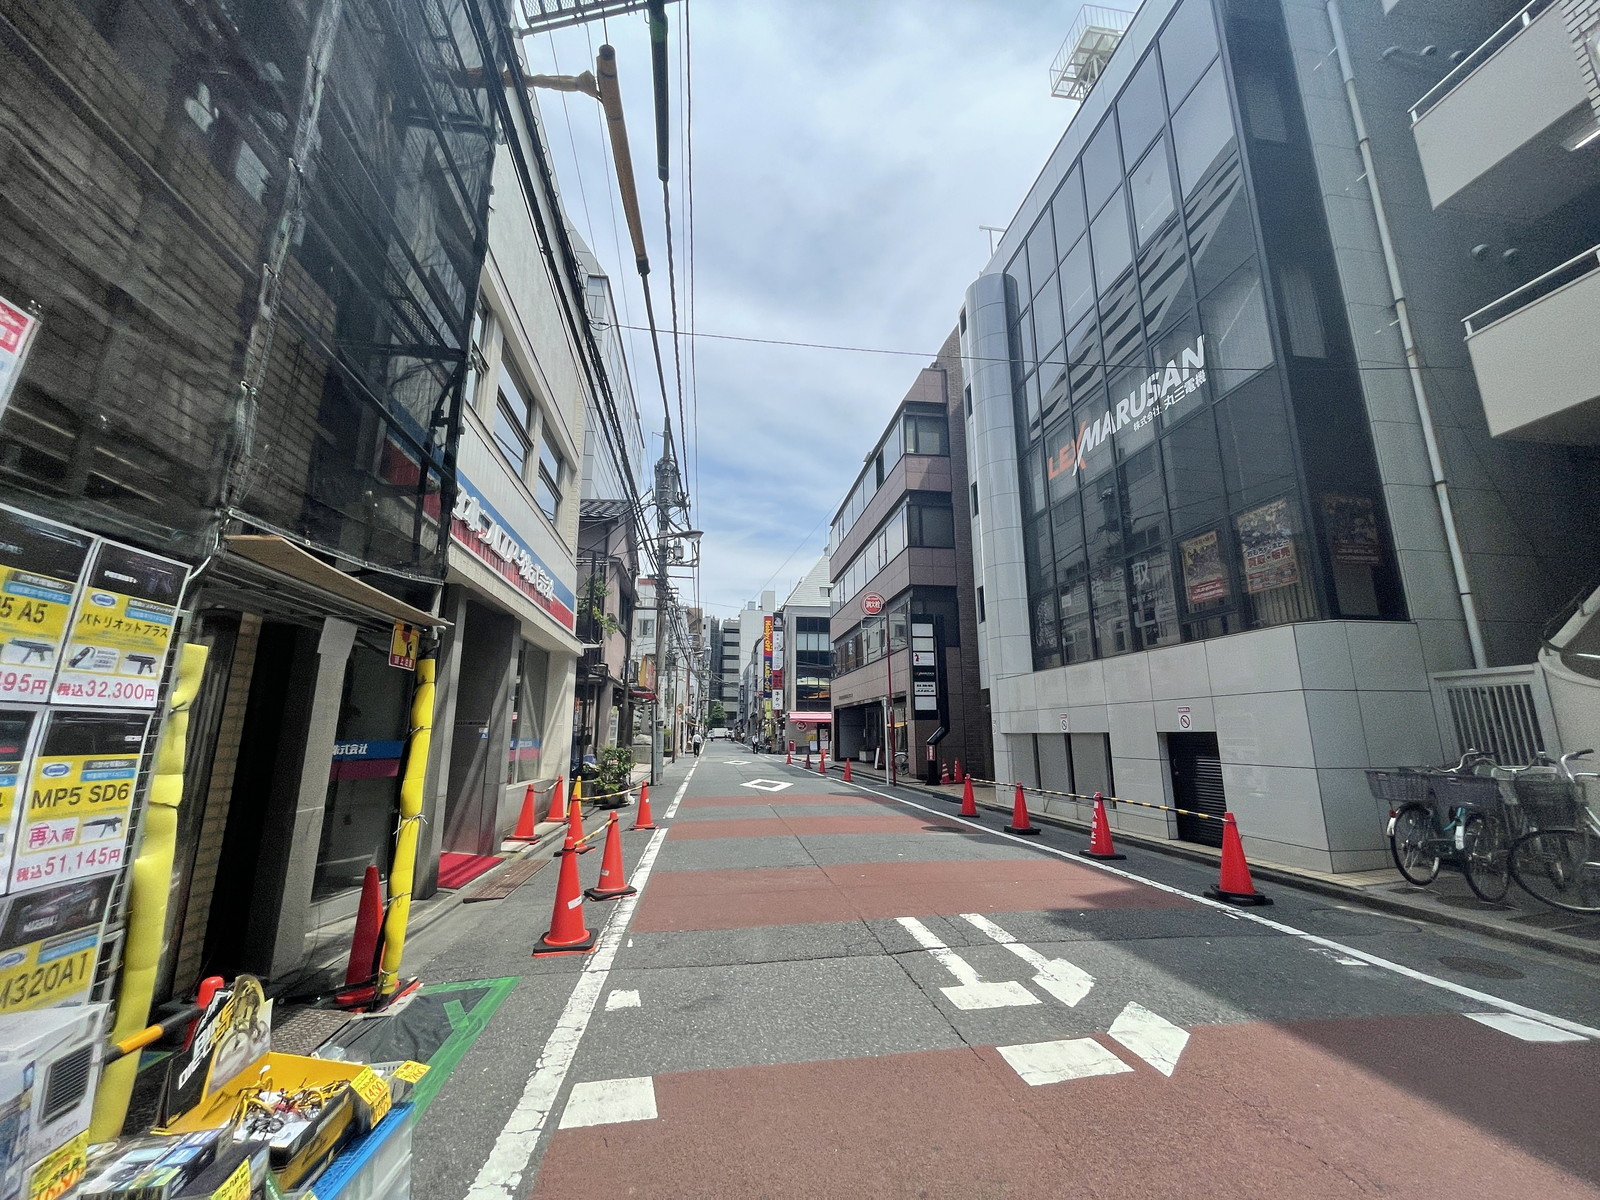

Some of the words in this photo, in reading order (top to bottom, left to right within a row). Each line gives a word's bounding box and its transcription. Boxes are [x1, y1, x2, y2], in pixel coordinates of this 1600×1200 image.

[1163, 369, 1207, 411] 丸三電機
[1048, 420, 1087, 480] LEX
[1072, 334, 1205, 476] MARUSAN
[17, 600, 48, 623] A5
[0, 671, 47, 695] 95円
[31, 787, 82, 809] MP5
[88, 783, 130, 804] SD6
[28, 824, 76, 847] 再入荷
